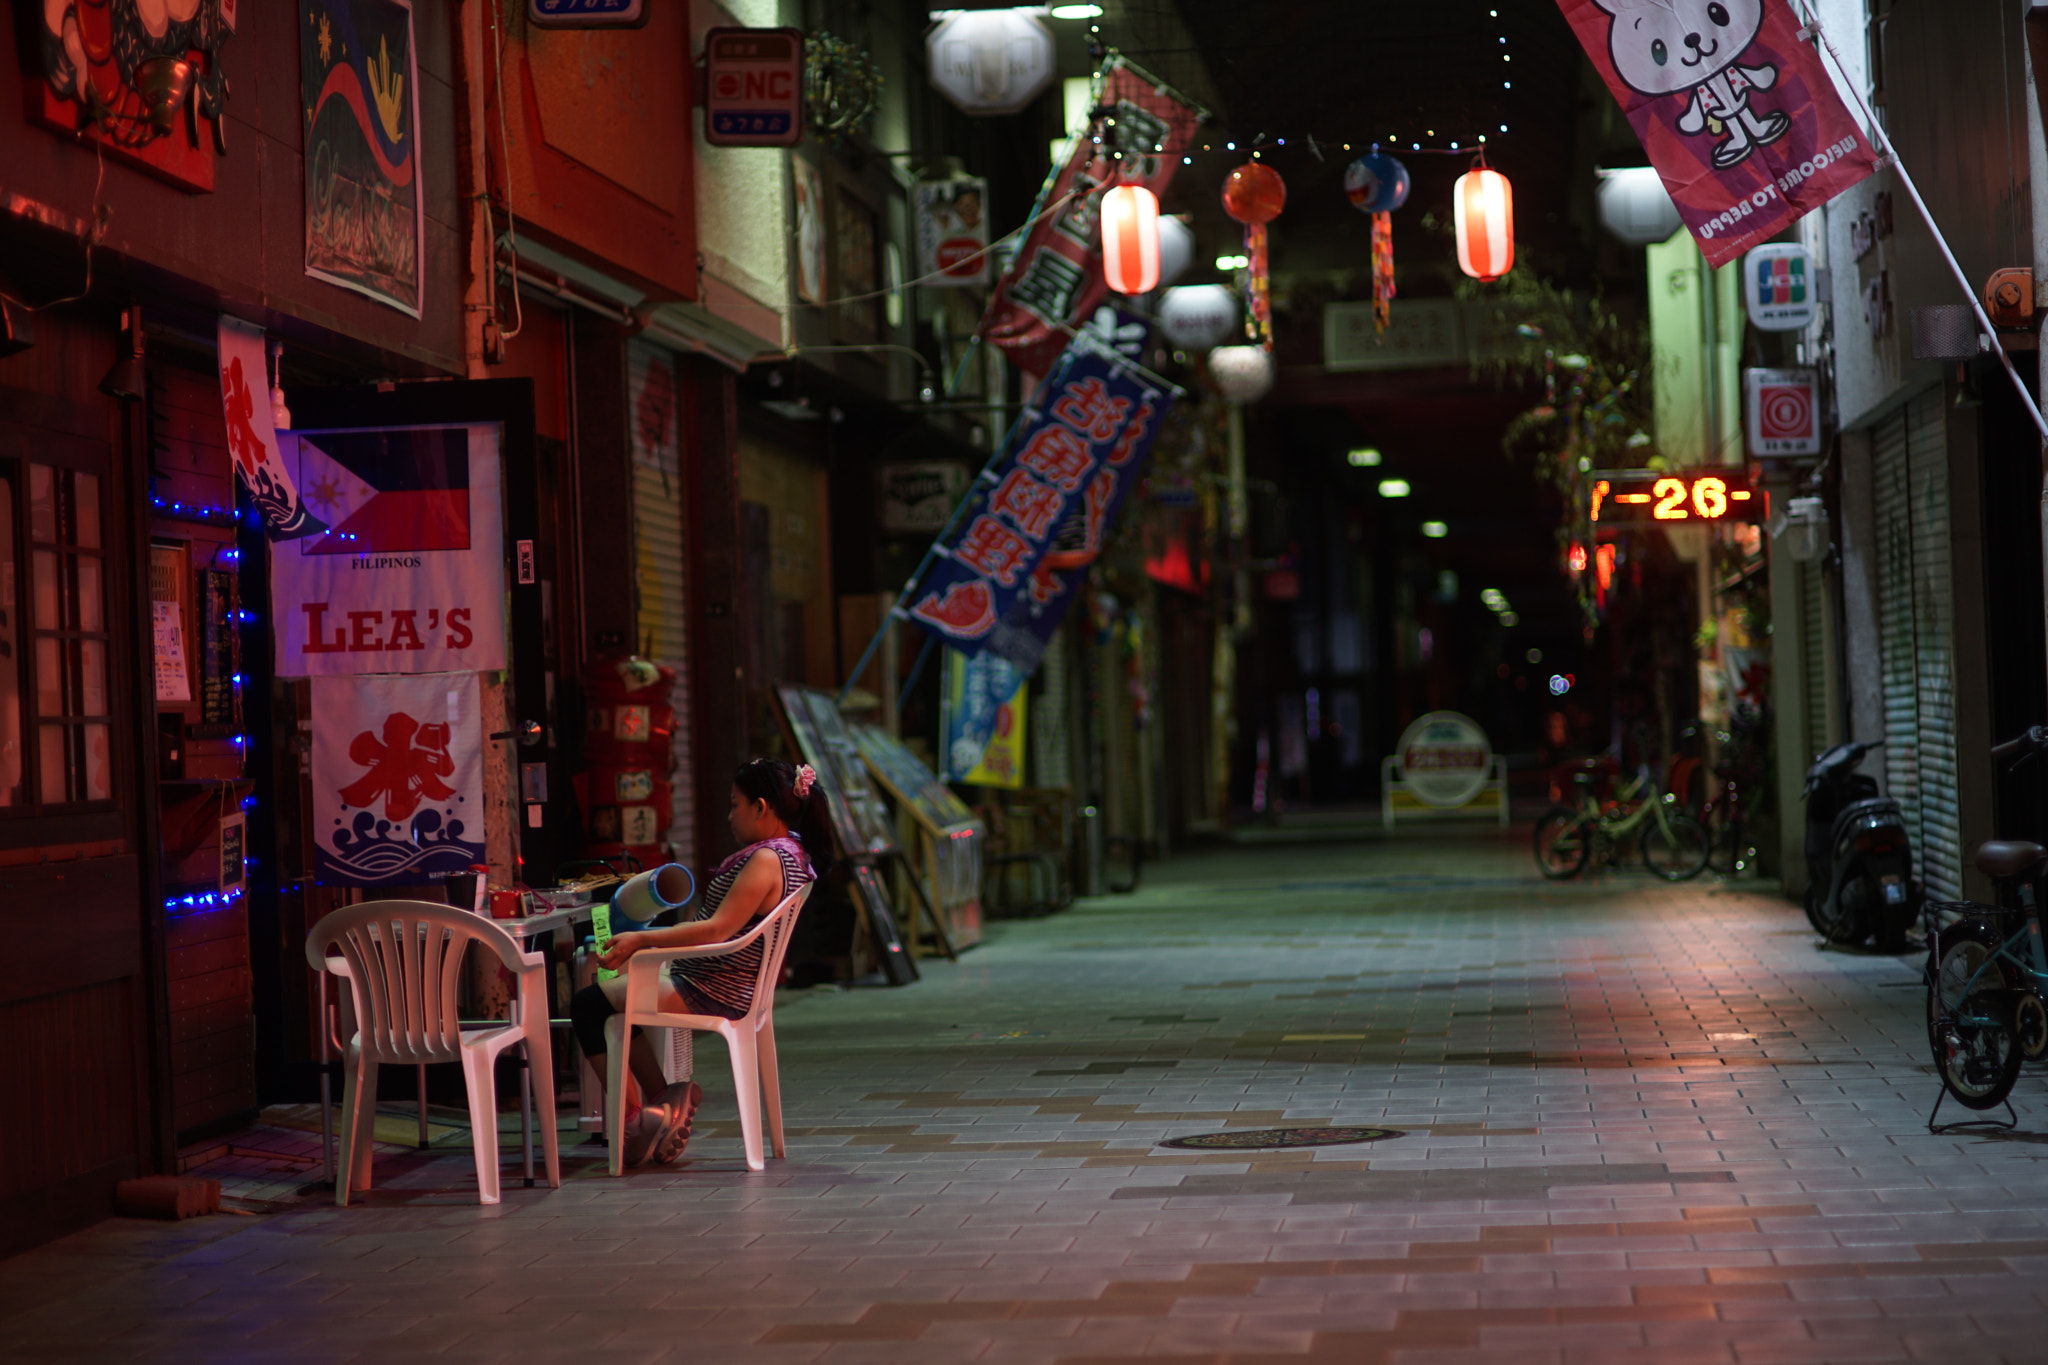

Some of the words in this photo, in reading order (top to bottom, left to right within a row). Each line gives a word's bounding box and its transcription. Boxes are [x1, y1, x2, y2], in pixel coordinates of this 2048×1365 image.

[1759, 273, 1805, 289] JCB
[351, 556, 422, 570] FILIPINOS
[302, 602, 474, 654] LEA'S
[337, 711, 457, 823] 氷
